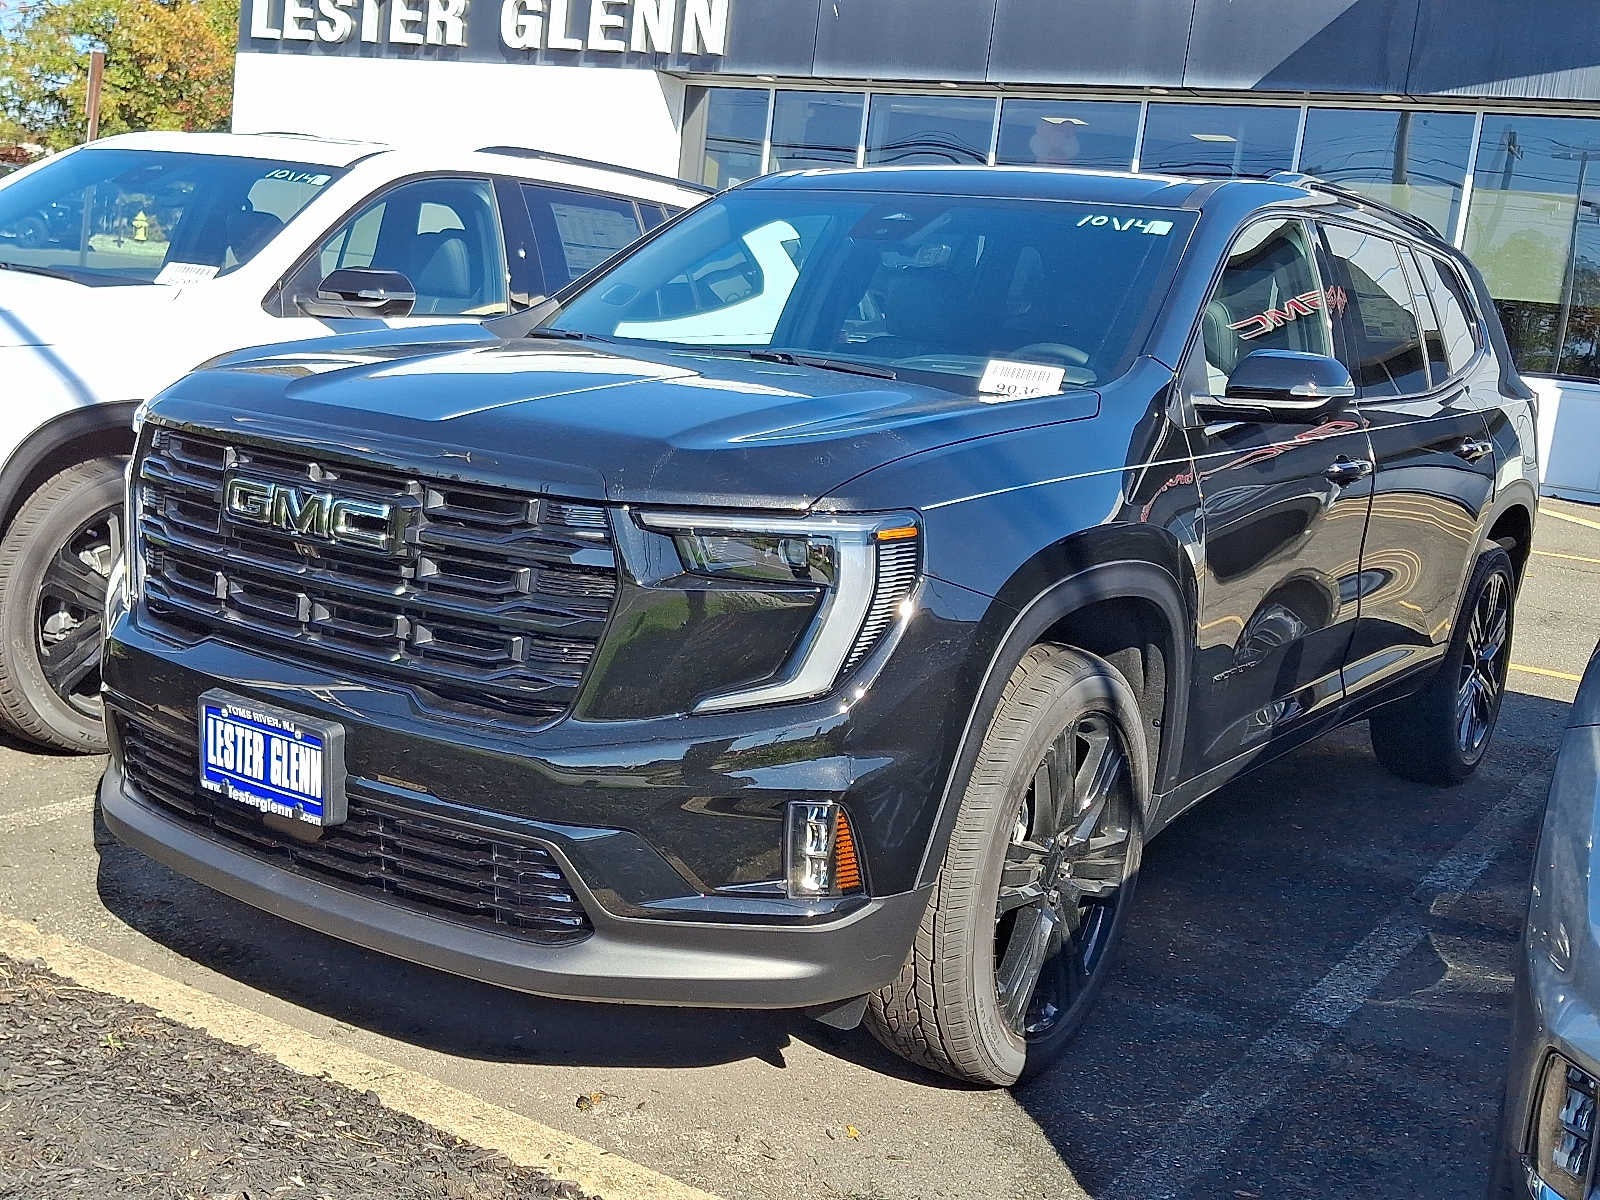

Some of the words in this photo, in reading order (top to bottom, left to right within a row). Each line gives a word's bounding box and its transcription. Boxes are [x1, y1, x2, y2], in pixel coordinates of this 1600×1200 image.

[250, 0, 467, 47] LESTER
[500, 0, 728, 56] GLENN
[226, 479, 393, 551] GMC
[207, 718, 264, 781] LESTER
[270, 737, 322, 799] GLENN
